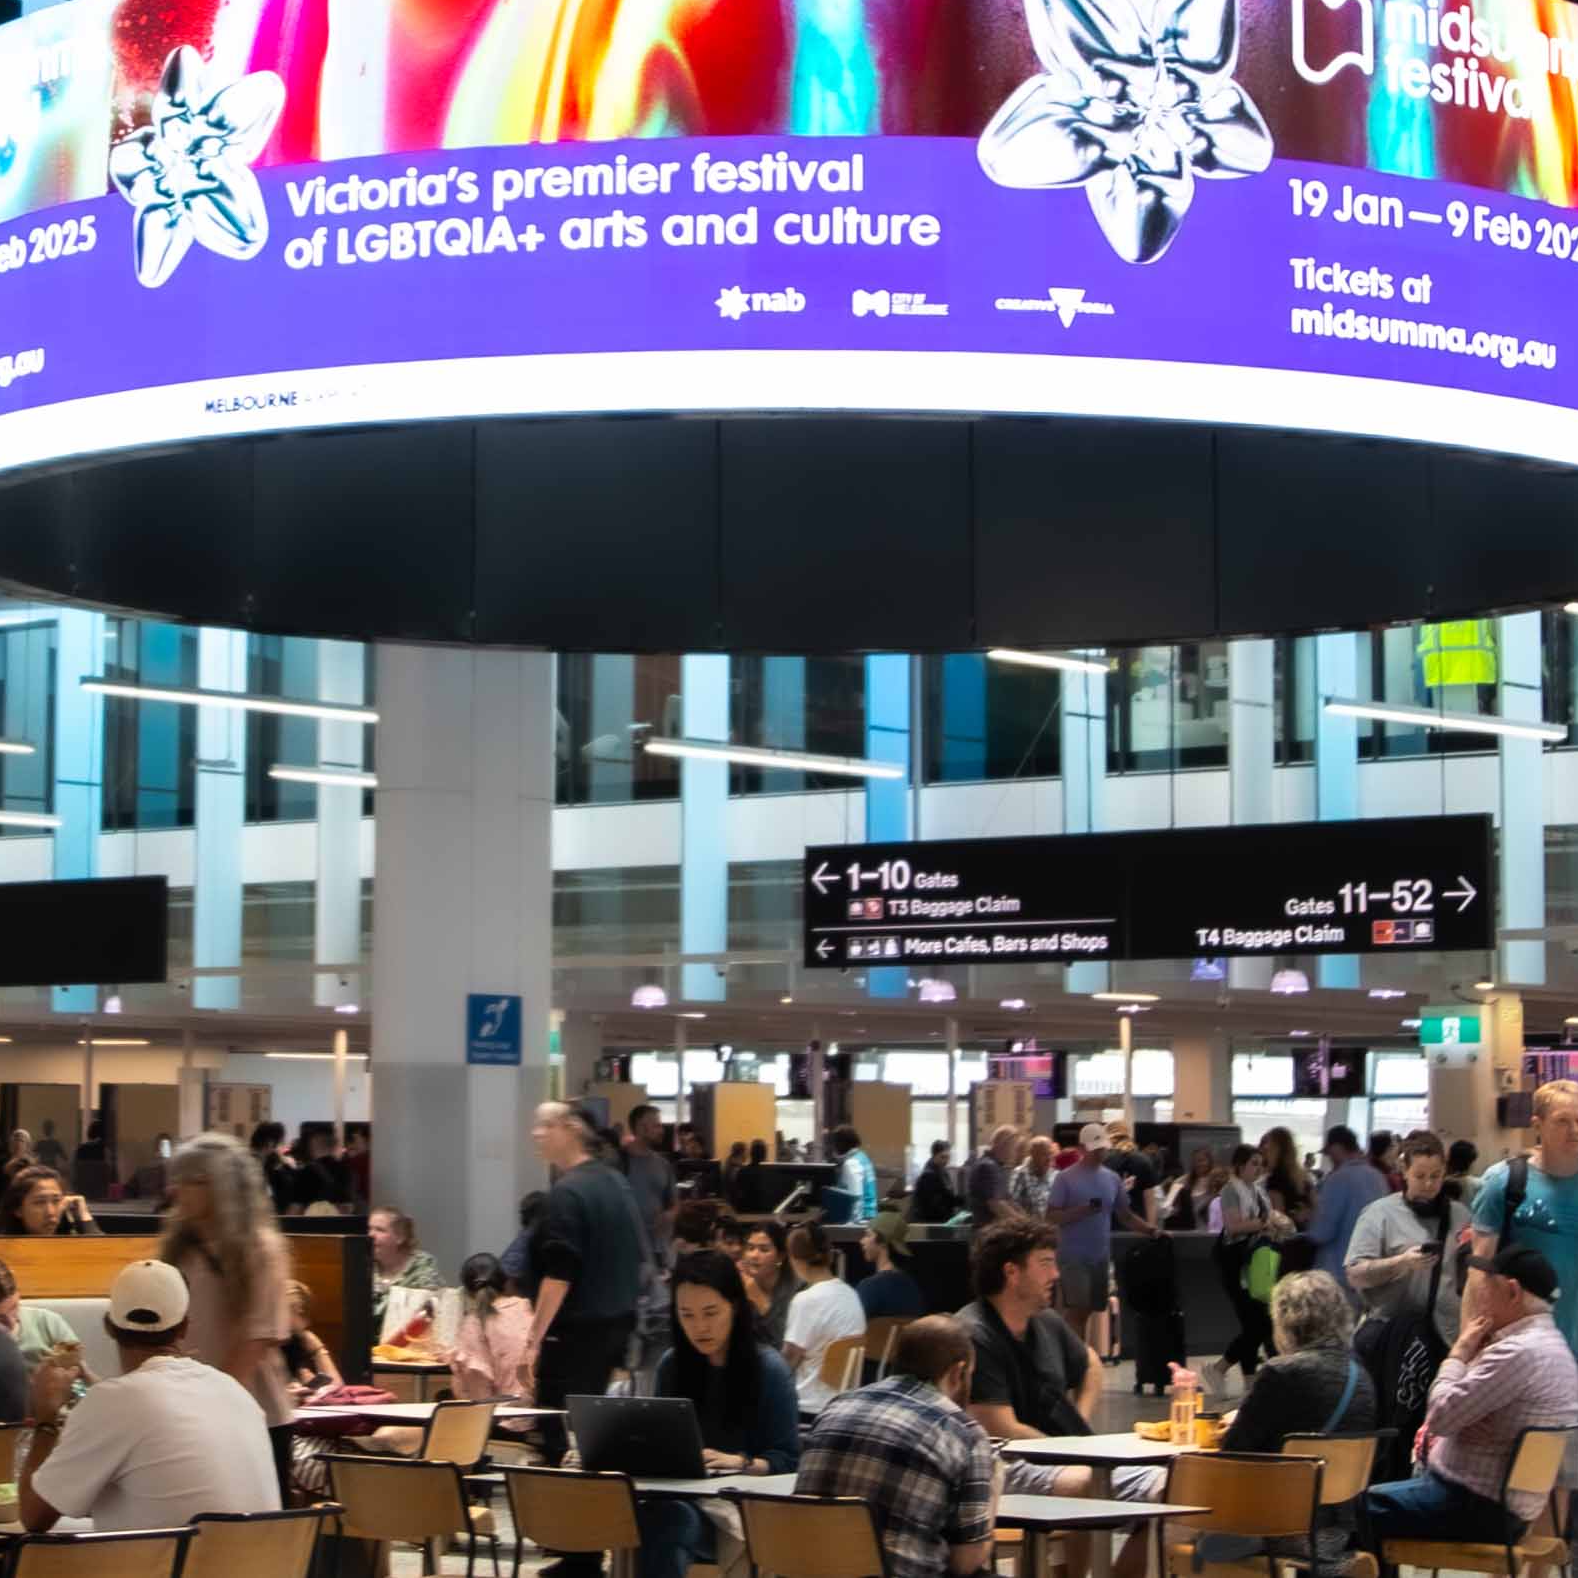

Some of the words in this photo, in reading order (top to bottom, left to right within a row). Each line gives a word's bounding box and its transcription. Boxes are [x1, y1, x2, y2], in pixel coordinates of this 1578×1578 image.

[1384, 44, 1540, 119] festiva
[285, 166, 480, 218] Victoria's
[492, 154, 681, 213] premier
[690, 151, 864, 193] festival
[1287, 178, 1329, 218] 19
[1332, 185, 1404, 229] Jan
[1445, 200, 1470, 238] 9
[1473, 205, 1532, 250] Feb
[27, 214, 97, 264] 2025
[283, 226, 329, 270] of
[336, 215, 546, 265] LGBTQIA+
[558, 209, 649, 250] arts
[661, 206, 759, 247] and
[772, 206, 942, 247] culture
[1289, 257, 1395, 300] Tickets
[1401, 273, 1433, 304] at
[752, 287, 806, 313] nab
[1290, 302, 1558, 370] midsumma.org.au
[204, 390, 298, 414] MELBOURNE
[914, 872, 960, 890] Gates
[887, 900, 909, 916] T3
[911, 897, 974, 918] Baggage
[974, 894, 1022, 913] Claim
[1285, 897, 1336, 916] Gates
[904, 938, 943, 955] More
[943, 936, 992, 955] Cafes,
[993, 934, 1035, 953] Bars
[1035, 935, 1059, 951] and
[1059, 933, 1110, 953] Shops
[1195, 928, 1221, 947] T4
[1222, 926, 1293, 950] Baggage
[1294, 924, 1346, 945] Claim
